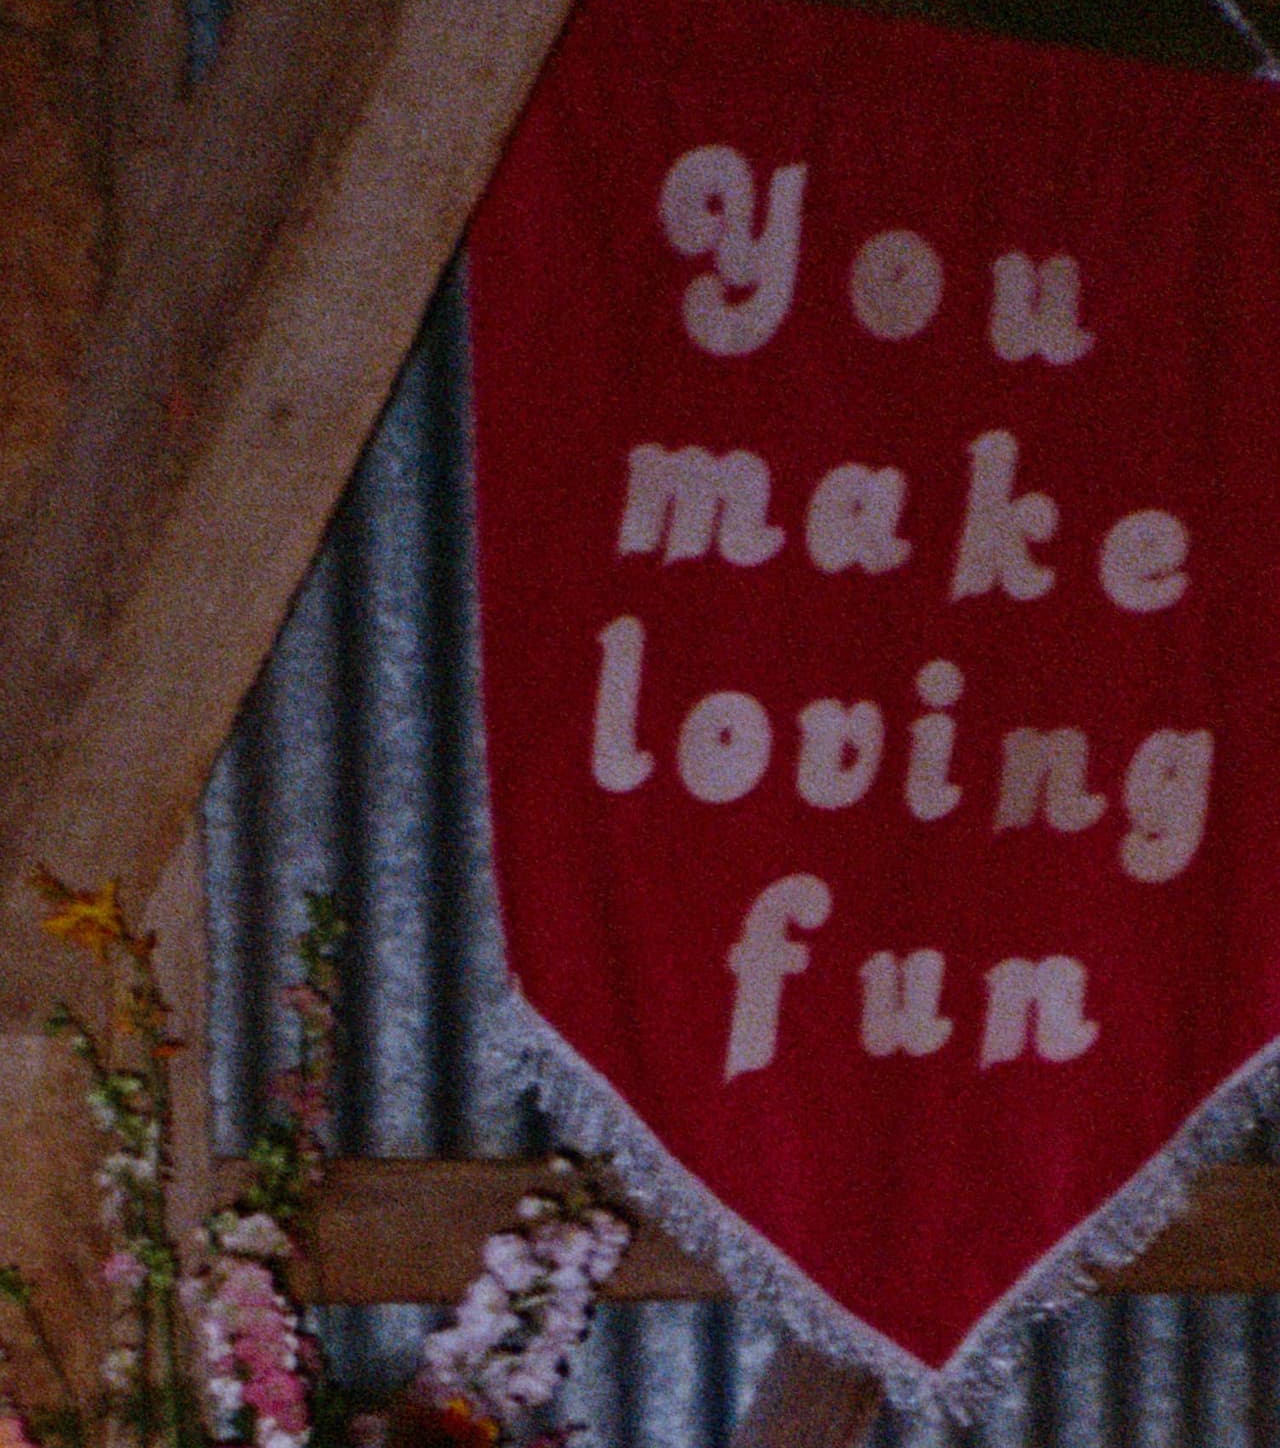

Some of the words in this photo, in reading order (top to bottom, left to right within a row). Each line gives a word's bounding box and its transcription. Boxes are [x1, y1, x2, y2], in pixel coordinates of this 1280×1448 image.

[616, 428, 1192, 612] make
[590, 614, 1214, 883] loving
[724, 872, 1100, 1082] fun
